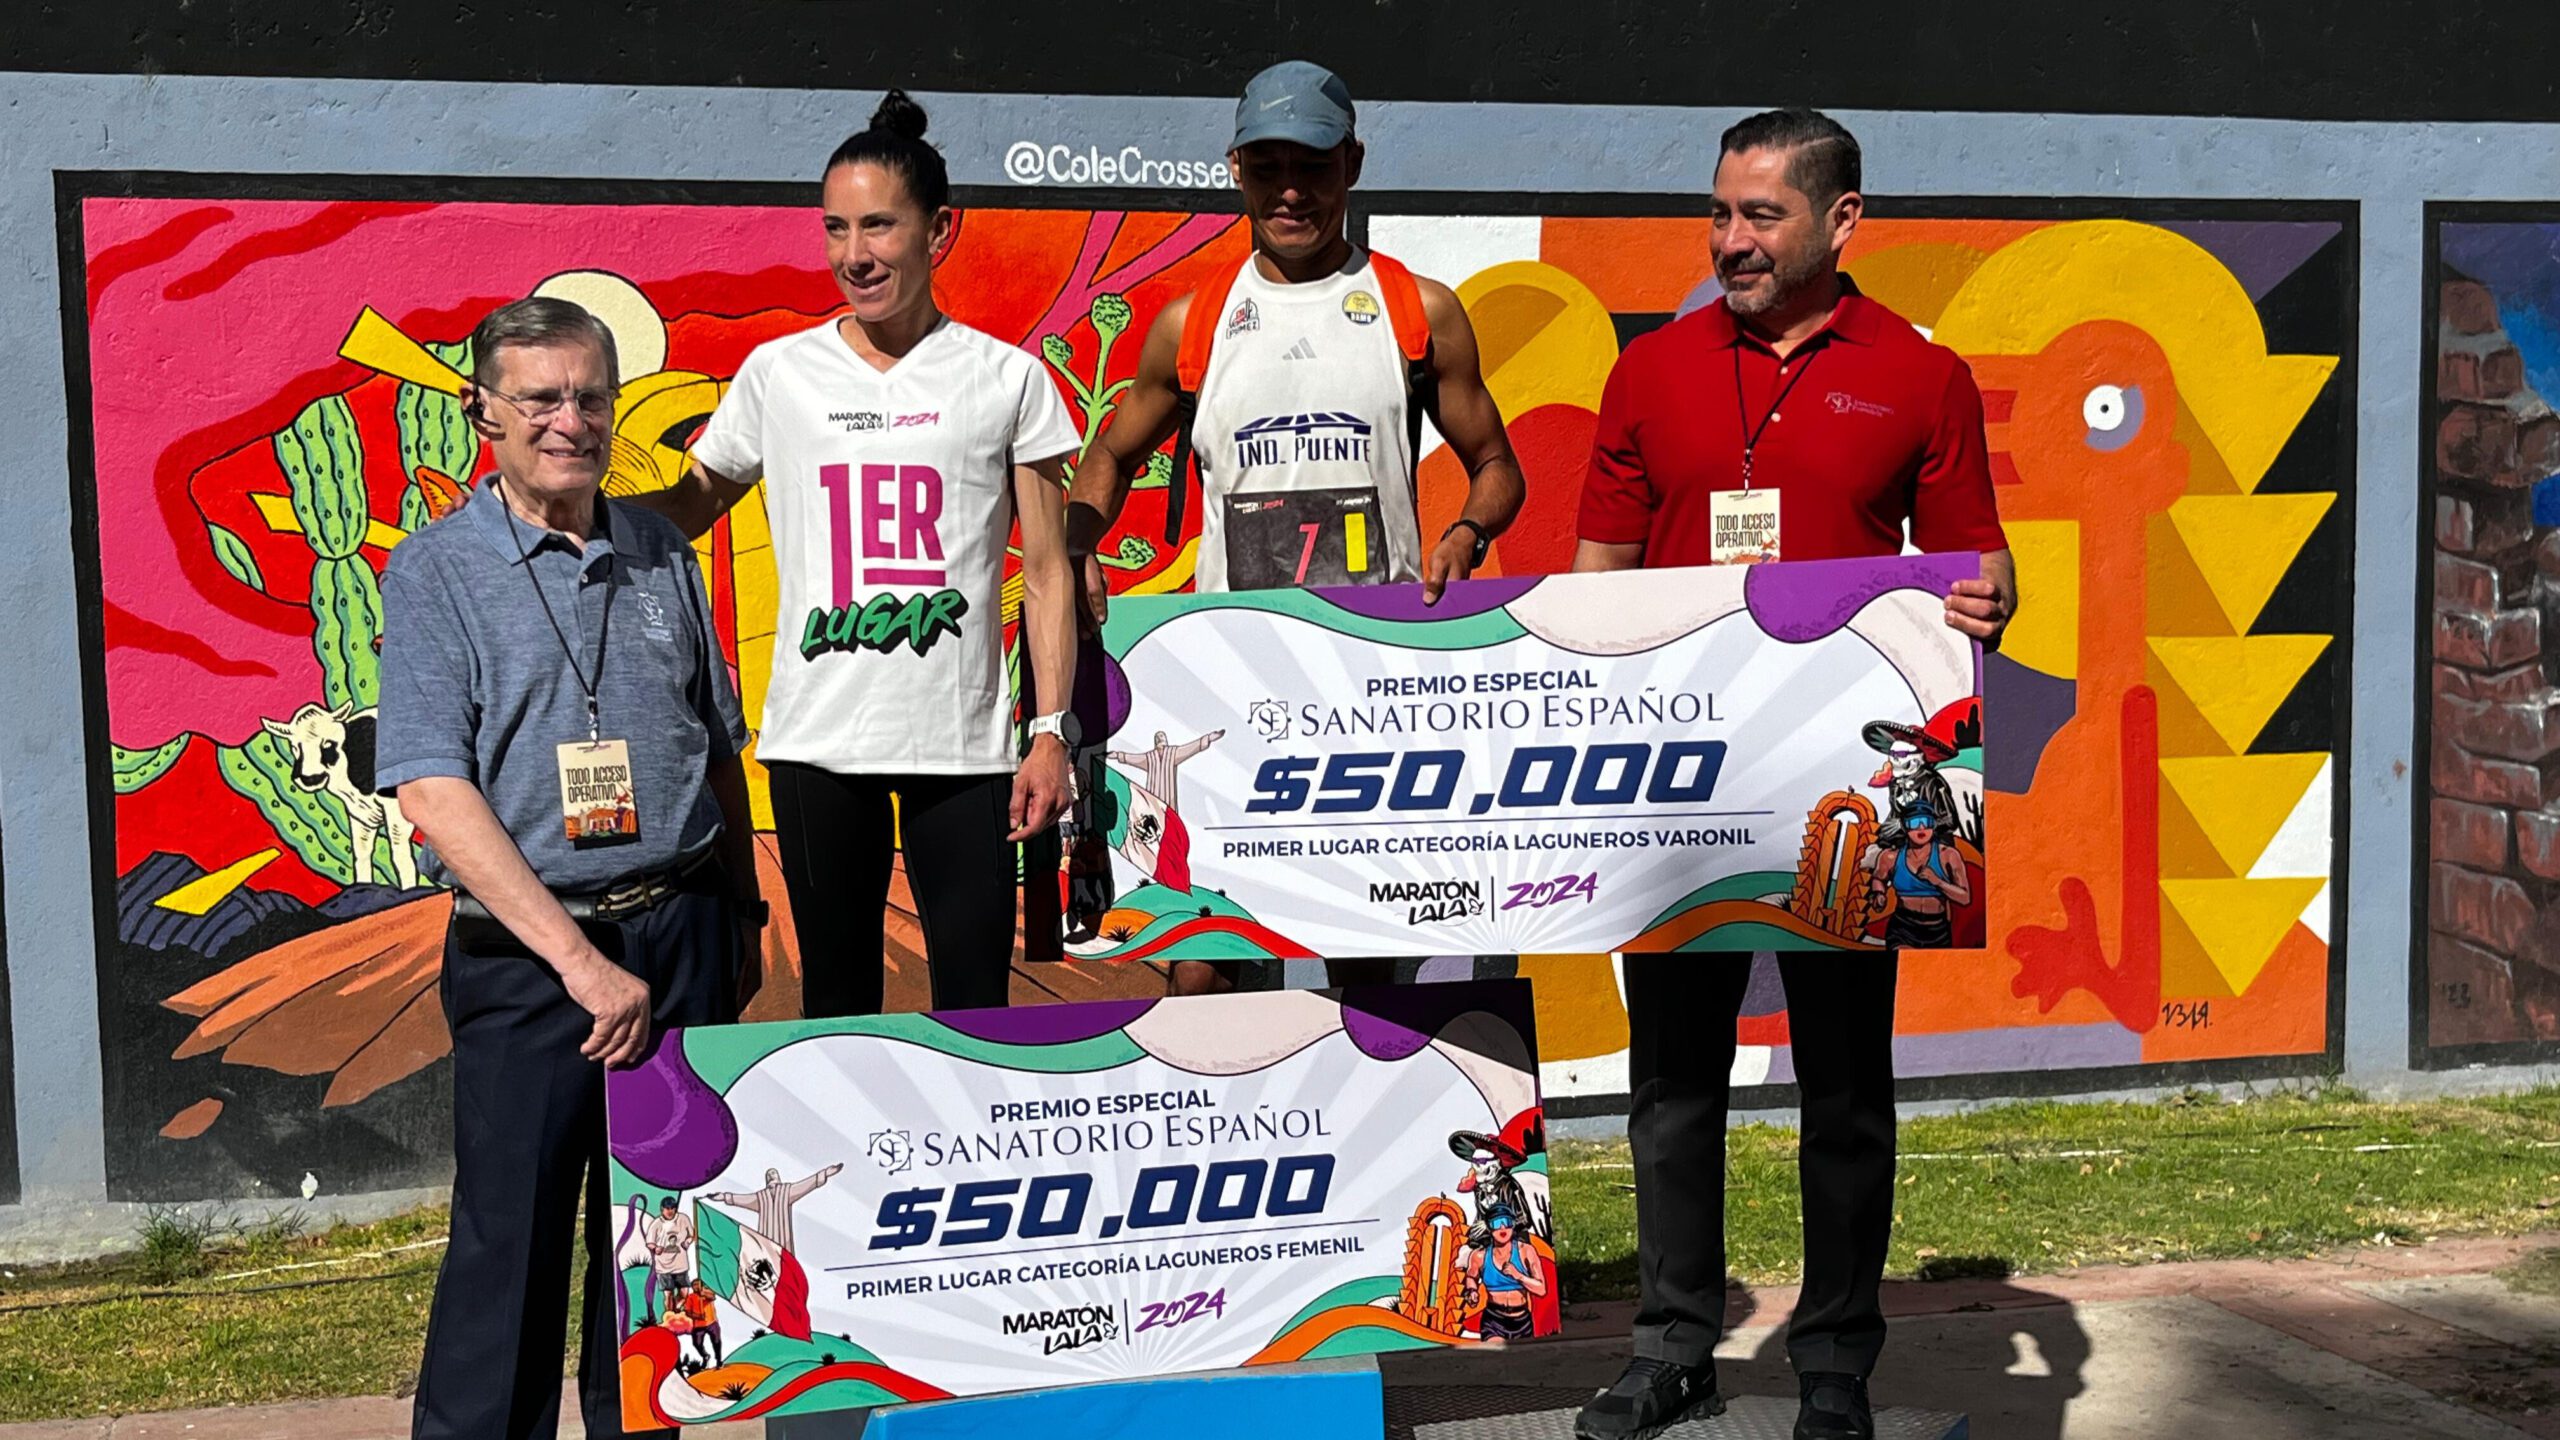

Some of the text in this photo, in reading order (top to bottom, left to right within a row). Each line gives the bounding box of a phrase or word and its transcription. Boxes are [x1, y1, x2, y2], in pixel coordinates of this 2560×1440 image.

[892, 411, 940, 428] 2024
[1294, 436, 1371, 463] PUENTE
[1715, 512, 1776, 531] TODO ACCESO
[1715, 530, 1763, 548] OPERATIVO
[800, 588, 969, 662] LUGAR
[1366, 669, 1598, 698] PREMIO ESPECIAL
[1300, 686, 1724, 737] SANATORIO ESPAÑOL
[566, 764, 628, 785] TODO ACCESO
[568, 782, 618, 803] OPERATIVO
[1223, 828, 1756, 858] PRIMER LUGAR CATEGORÍA LAGUNEROS VARONIL
[1369, 877, 1480, 903] MARATÓN
[1499, 871, 1599, 911] 2024
[1408, 900, 1468, 926] LALA
[990, 1088, 1216, 1123] PREMIO ESPECIAL
[923, 1104, 1332, 1166] SANATORIO ESPAÑOL
[846, 1236, 1365, 1300] PRIMER LUGAR CATEGORÍA LAGUNEROS FEMENIL
[1002, 1302, 1114, 1335] MARATÓN
[1134, 1287, 1227, 1333] 2024
[1043, 1324, 1103, 1356] LALA
